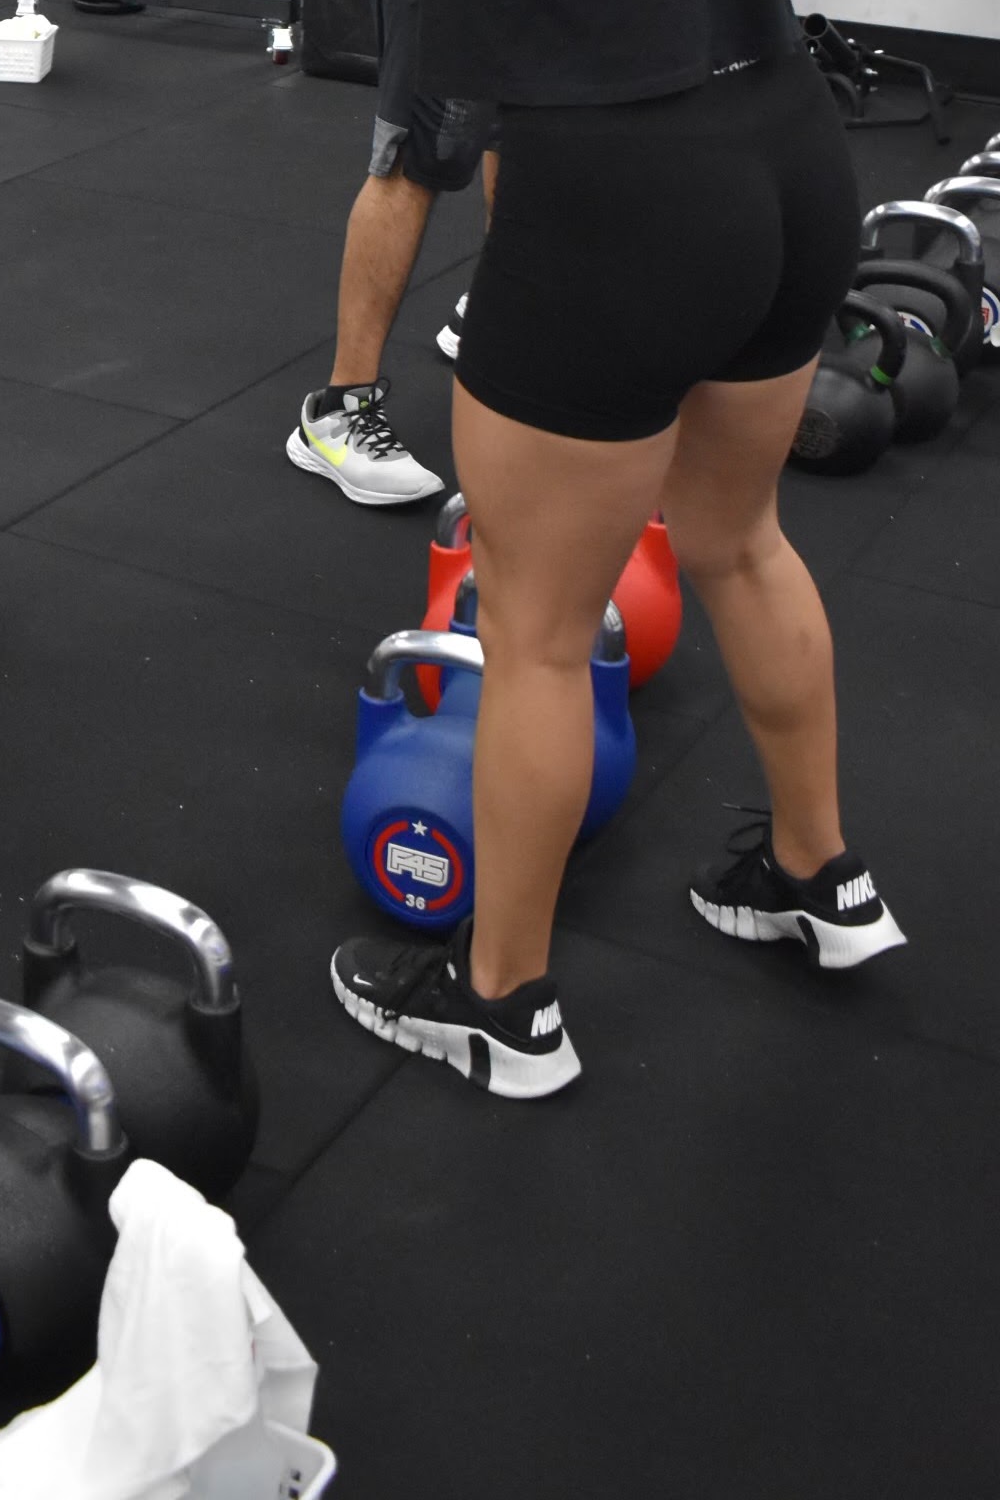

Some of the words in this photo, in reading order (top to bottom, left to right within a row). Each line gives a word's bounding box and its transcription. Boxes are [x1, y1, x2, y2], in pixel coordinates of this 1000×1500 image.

[386, 842, 449, 888] F45
[405, 893, 426, 911] 36
[836, 869, 877, 912] NIK
[530, 998, 562, 1037] NIK
